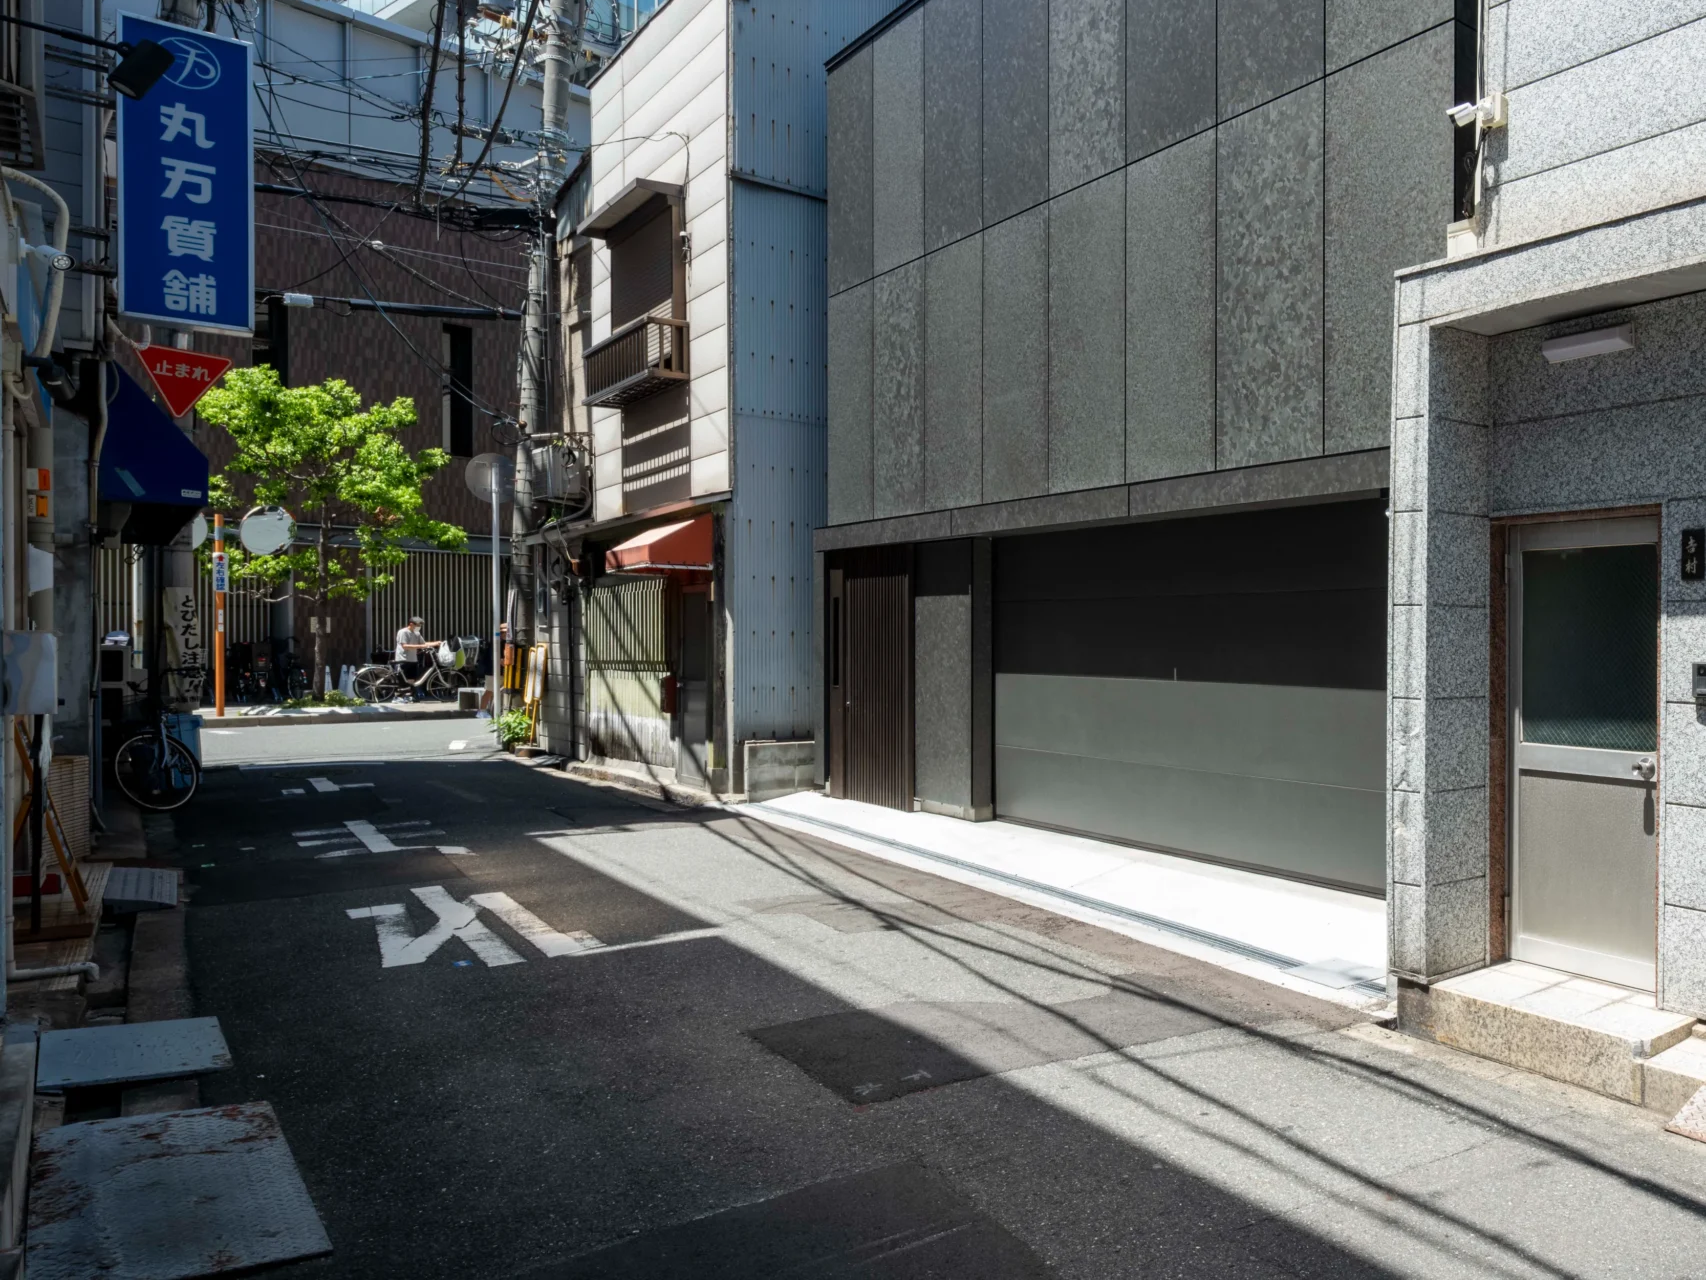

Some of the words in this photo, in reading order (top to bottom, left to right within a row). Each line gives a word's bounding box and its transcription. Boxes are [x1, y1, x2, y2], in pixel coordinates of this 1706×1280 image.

[160, 102, 217, 316] 丸万質舗
[153, 360, 211, 382] 止まれ
[215, 562, 226, 591] 左右確認
